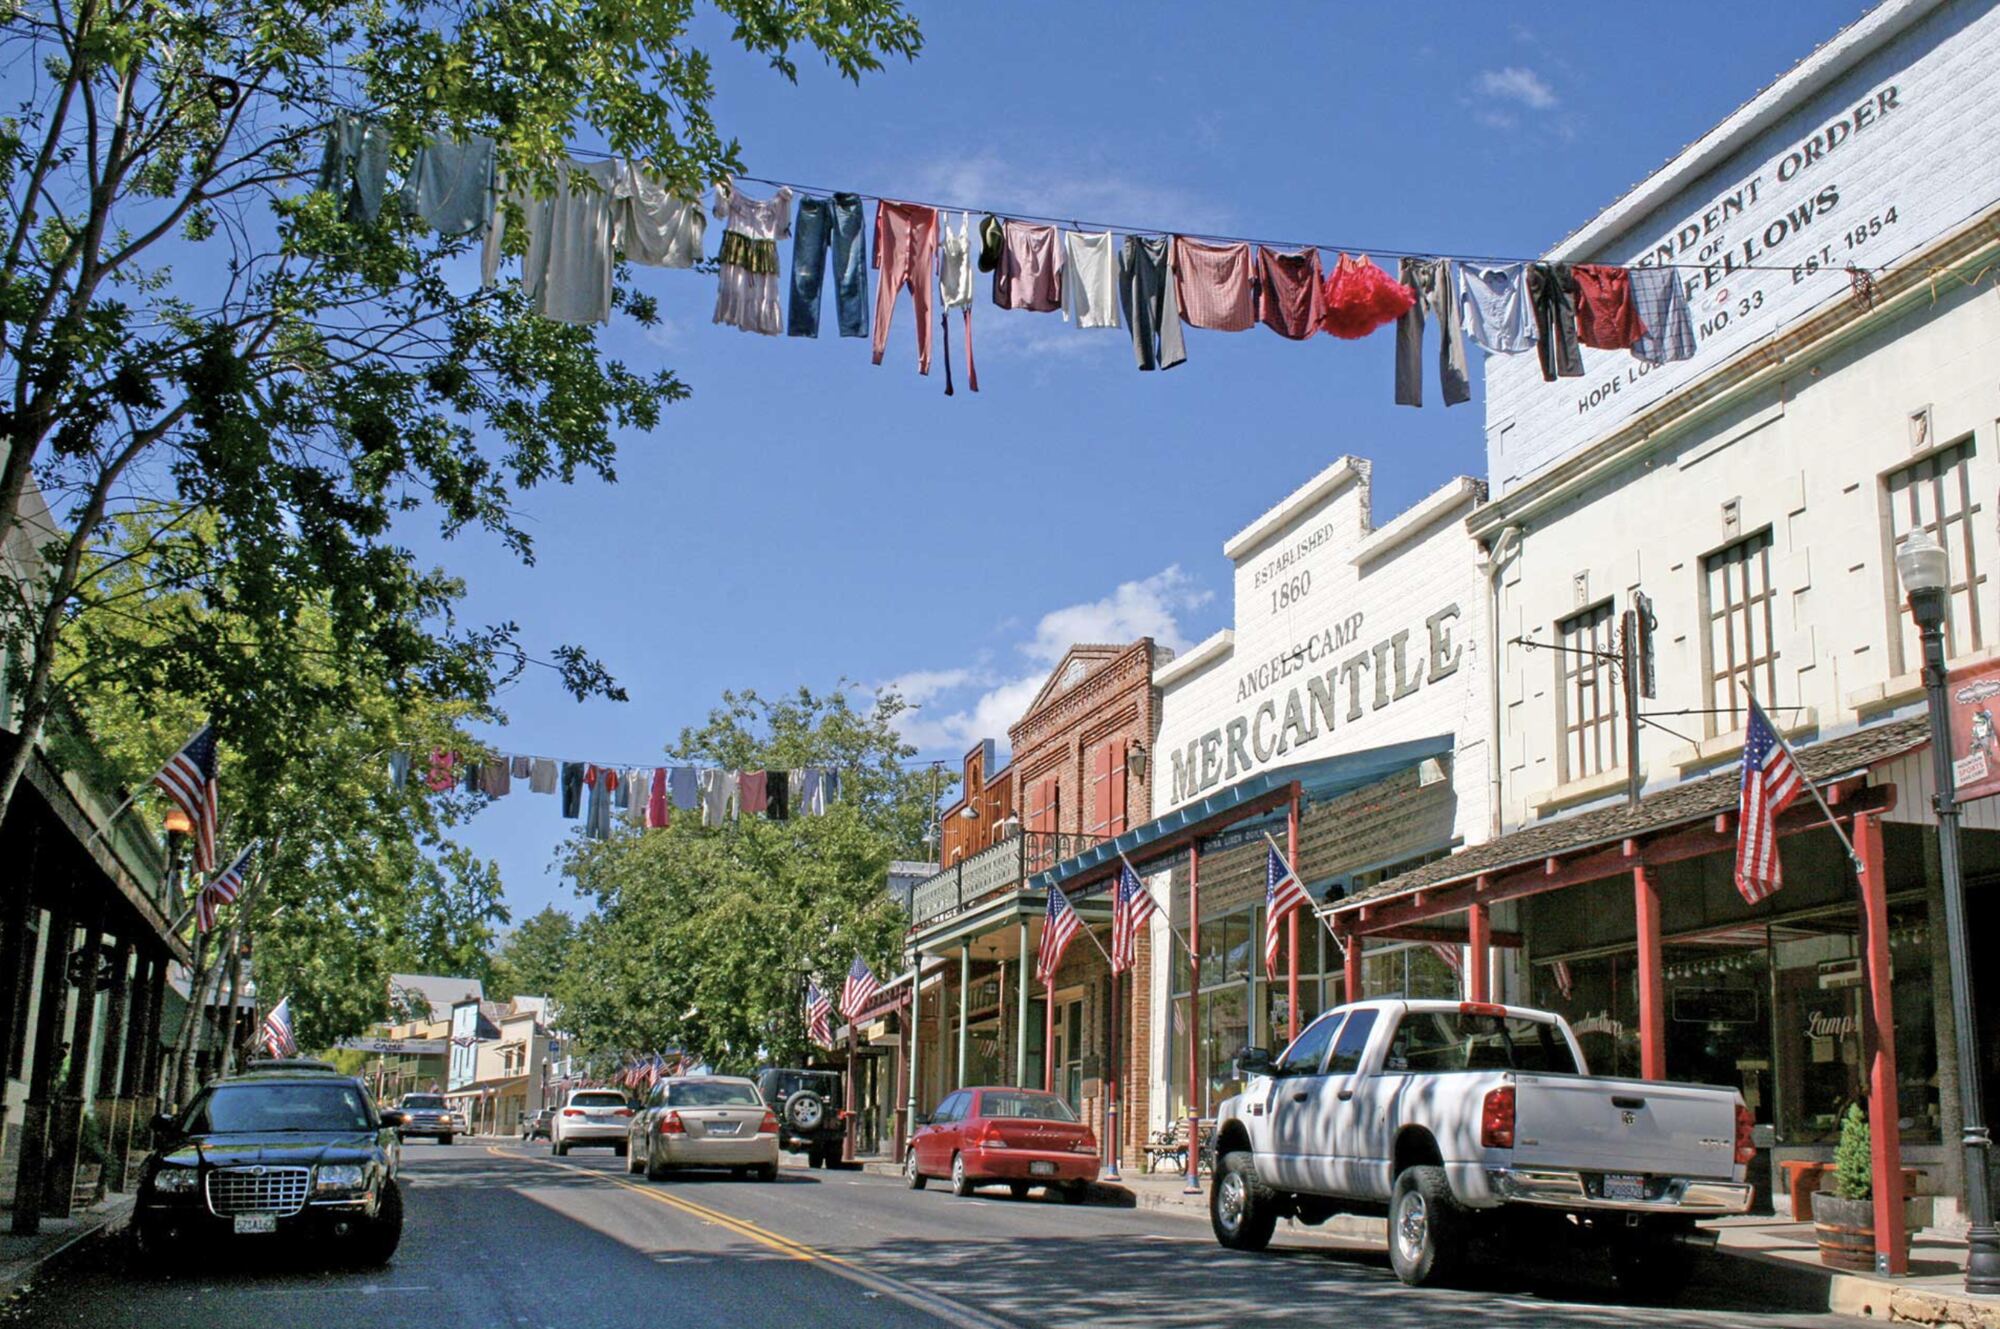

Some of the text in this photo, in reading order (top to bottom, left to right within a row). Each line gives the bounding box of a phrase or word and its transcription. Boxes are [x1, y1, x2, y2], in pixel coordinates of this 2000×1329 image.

[1636, 84, 1900, 268] ENDENT ORDER
[1683, 184, 1840, 302] FELLOWS
[1698, 235, 1725, 262] OF
[1578, 375, 1621, 414] HOPE
[1738, 290, 1765, 318] 33
[1792, 244, 1837, 286] EST.
[1844, 205, 1899, 251] 1854
[1254, 523, 1334, 589] ESTABLISHED
[1271, 569, 1312, 614] 1860
[1170, 602, 1463, 806] MERCANTILE
[1236, 612, 1364, 703] ANGELS CAMP
